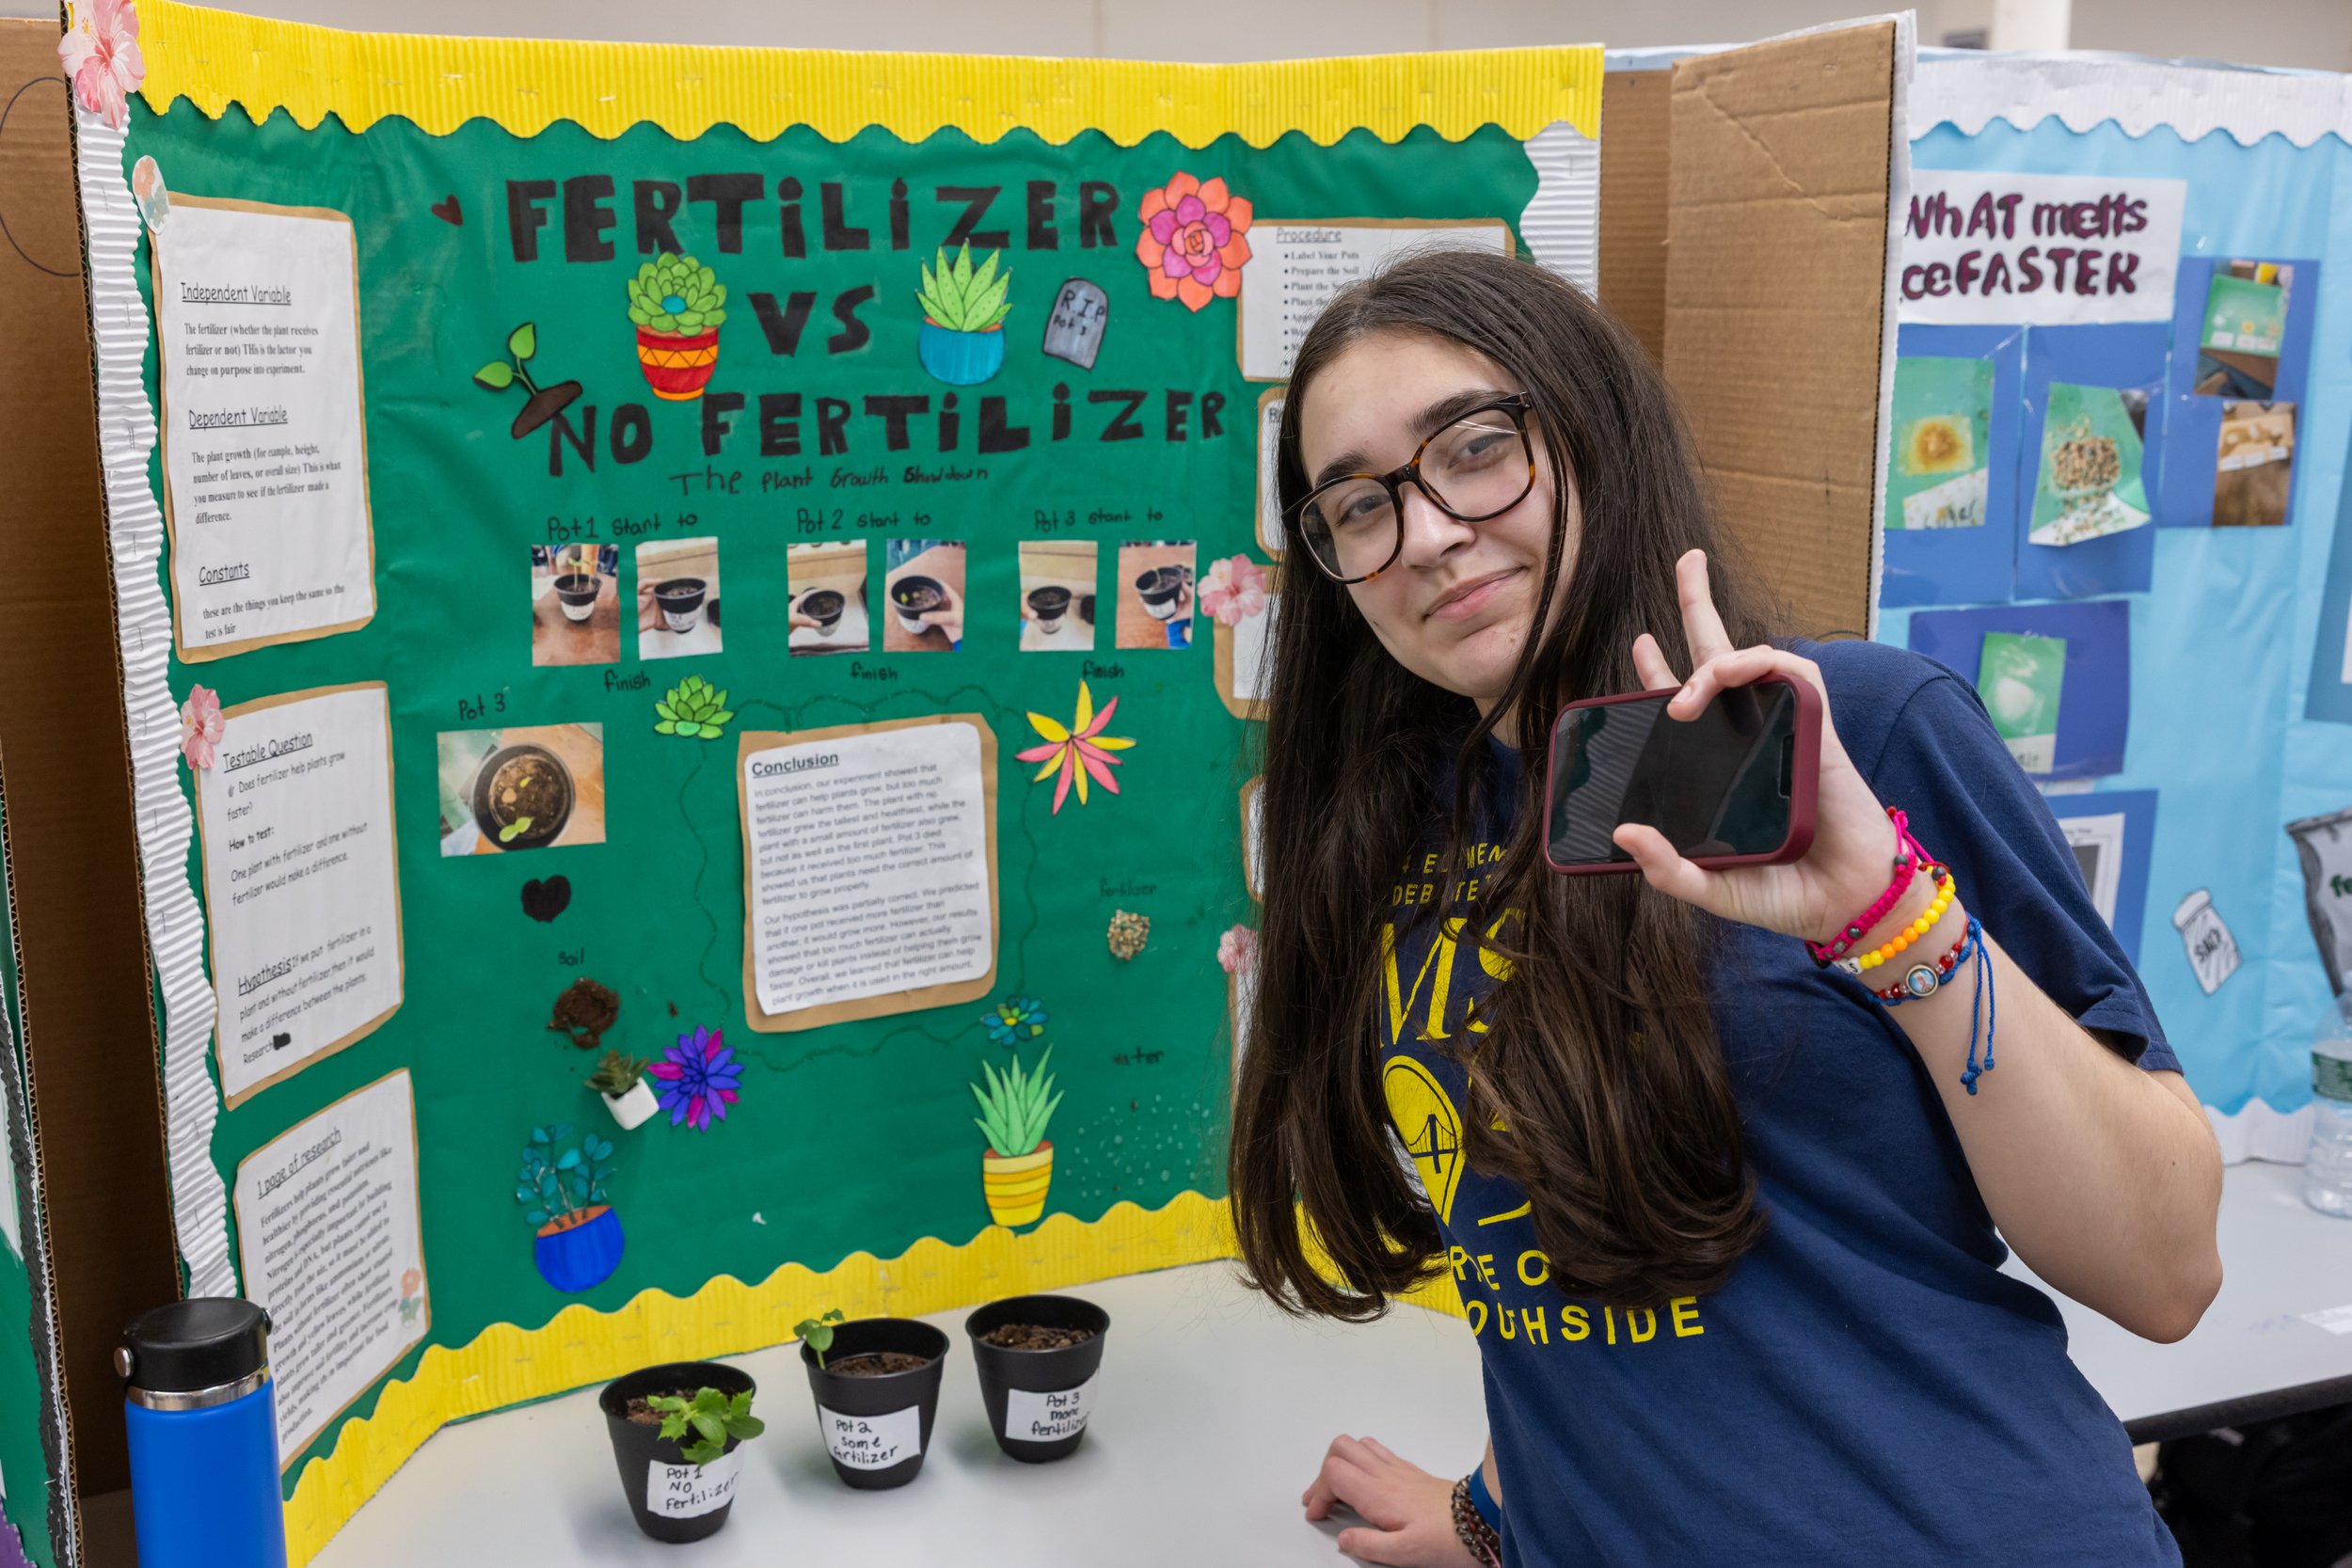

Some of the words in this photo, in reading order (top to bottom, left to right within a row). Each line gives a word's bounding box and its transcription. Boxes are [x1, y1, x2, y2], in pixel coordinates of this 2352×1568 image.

[2032, 194, 2148, 238] melts
[1277, 227, 1342, 244] Procedure
[1292, 251, 1315, 260] Label
[1319, 251, 1337, 260] Your
[1342, 251, 1359, 260] Pots
[1292, 266, 1324, 277] Prepare
[1327, 267, 1340, 276] the
[1343, 266, 1359, 275] Soil
[1956, 246, 2139, 295] FASTER
[181, 282, 248, 306] Independent
[250, 285, 292, 304] Variable
[1291, 282, 1313, 291] Plant
[184, 324, 197, 335] The
[198, 324, 228, 336] fertilizer
[230, 324, 261, 337] (whether
[747, 285, 875, 357] VS
[185, 344, 214, 356] fertilizer
[215, 346, 221, 355] or
[225, 345, 241, 356] not)
[186, 365, 209, 377] change
[211, 366, 218, 375] on
[220, 365, 252, 377] purpose
[189, 407, 246, 431] Dependent
[250, 405, 288, 424] Variable
[549, 403, 653, 476] NO
[191, 451, 205, 464] The
[206, 451, 223, 465] plant
[225, 448, 251, 464] growth
[193, 471, 218, 483] number
[220, 469, 229, 482] of
[230, 469, 253, 481] leaves,
[669, 465, 741, 497] The
[194, 494, 207, 508] you
[208, 492, 236, 502] measure
[238, 490, 245, 499] to
[246, 490, 259, 499] see
[196, 512, 232, 524] difference.
[548, 516, 581, 541] Pot
[586, 516, 599, 538] 1
[676, 514, 698, 526] to
[797, 507, 824, 534] Pot
[832, 508, 843, 530] 2
[913, 511, 931, 526] to
[1034, 509, 1059, 533] Pot
[1065, 510, 1076, 527] 3
[1147, 506, 1163, 523] to
[199, 562, 250, 587] Constants
[203, 608, 219, 619] these
[221, 606, 231, 616] are
[232, 603, 244, 613] the
[245, 599, 265, 611] things
[279, 594, 294, 605] keep
[295, 591, 307, 601] the
[205, 629, 216, 640] test
[224, 624, 236, 636] fair
[458, 694, 485, 721] Pot
[495, 692, 506, 713] 3
[223, 743, 266, 771] Testable
[268, 733, 313, 757] Question
[239, 779, 255, 793] Does
[257, 768, 289, 787] fertilizer
[291, 761, 305, 775] help
[307, 756, 327, 772] plants
[752, 752, 839, 779] Conclusion
[755, 800, 789, 812] fertilizer
[792, 796, 808, 806] can
[810, 793, 829, 801] help
[832, 789, 858, 800] plants
[885, 783, 900, 791] but
[902, 781, 915, 789] too
[918, 776, 943, 786] much
[228, 801, 253, 821] faster?
[230, 838, 246, 851] How
[247, 832, 255, 844] to
[256, 827, 275, 841] test:
[230, 869, 246, 882] One
[248, 861, 262, 879] plant
[264, 853, 281, 867] with
[283, 843, 314, 863] fertilizer
[232, 885, 263, 906] fertilizer
[265, 874, 286, 891] would
[238, 957, 292, 995] Hypothesis
[240, 1003, 256, 1023] plant
[265, 1005, 301, 1029] difference
[243, 1039, 274, 1065] Research
[264, 1167, 287, 1193] page
[288, 1153, 298, 1176] of
[300, 1127, 341, 1165] research
[1046, 1394, 1067, 1408] Pot
[1071, 1391, 1080, 1405] 3
[836, 1419, 853, 1433] Pot
[857, 1421, 872, 1433] 2
[666, 1467, 690, 1480] Pot
[694, 1466, 704, 1480] 1
